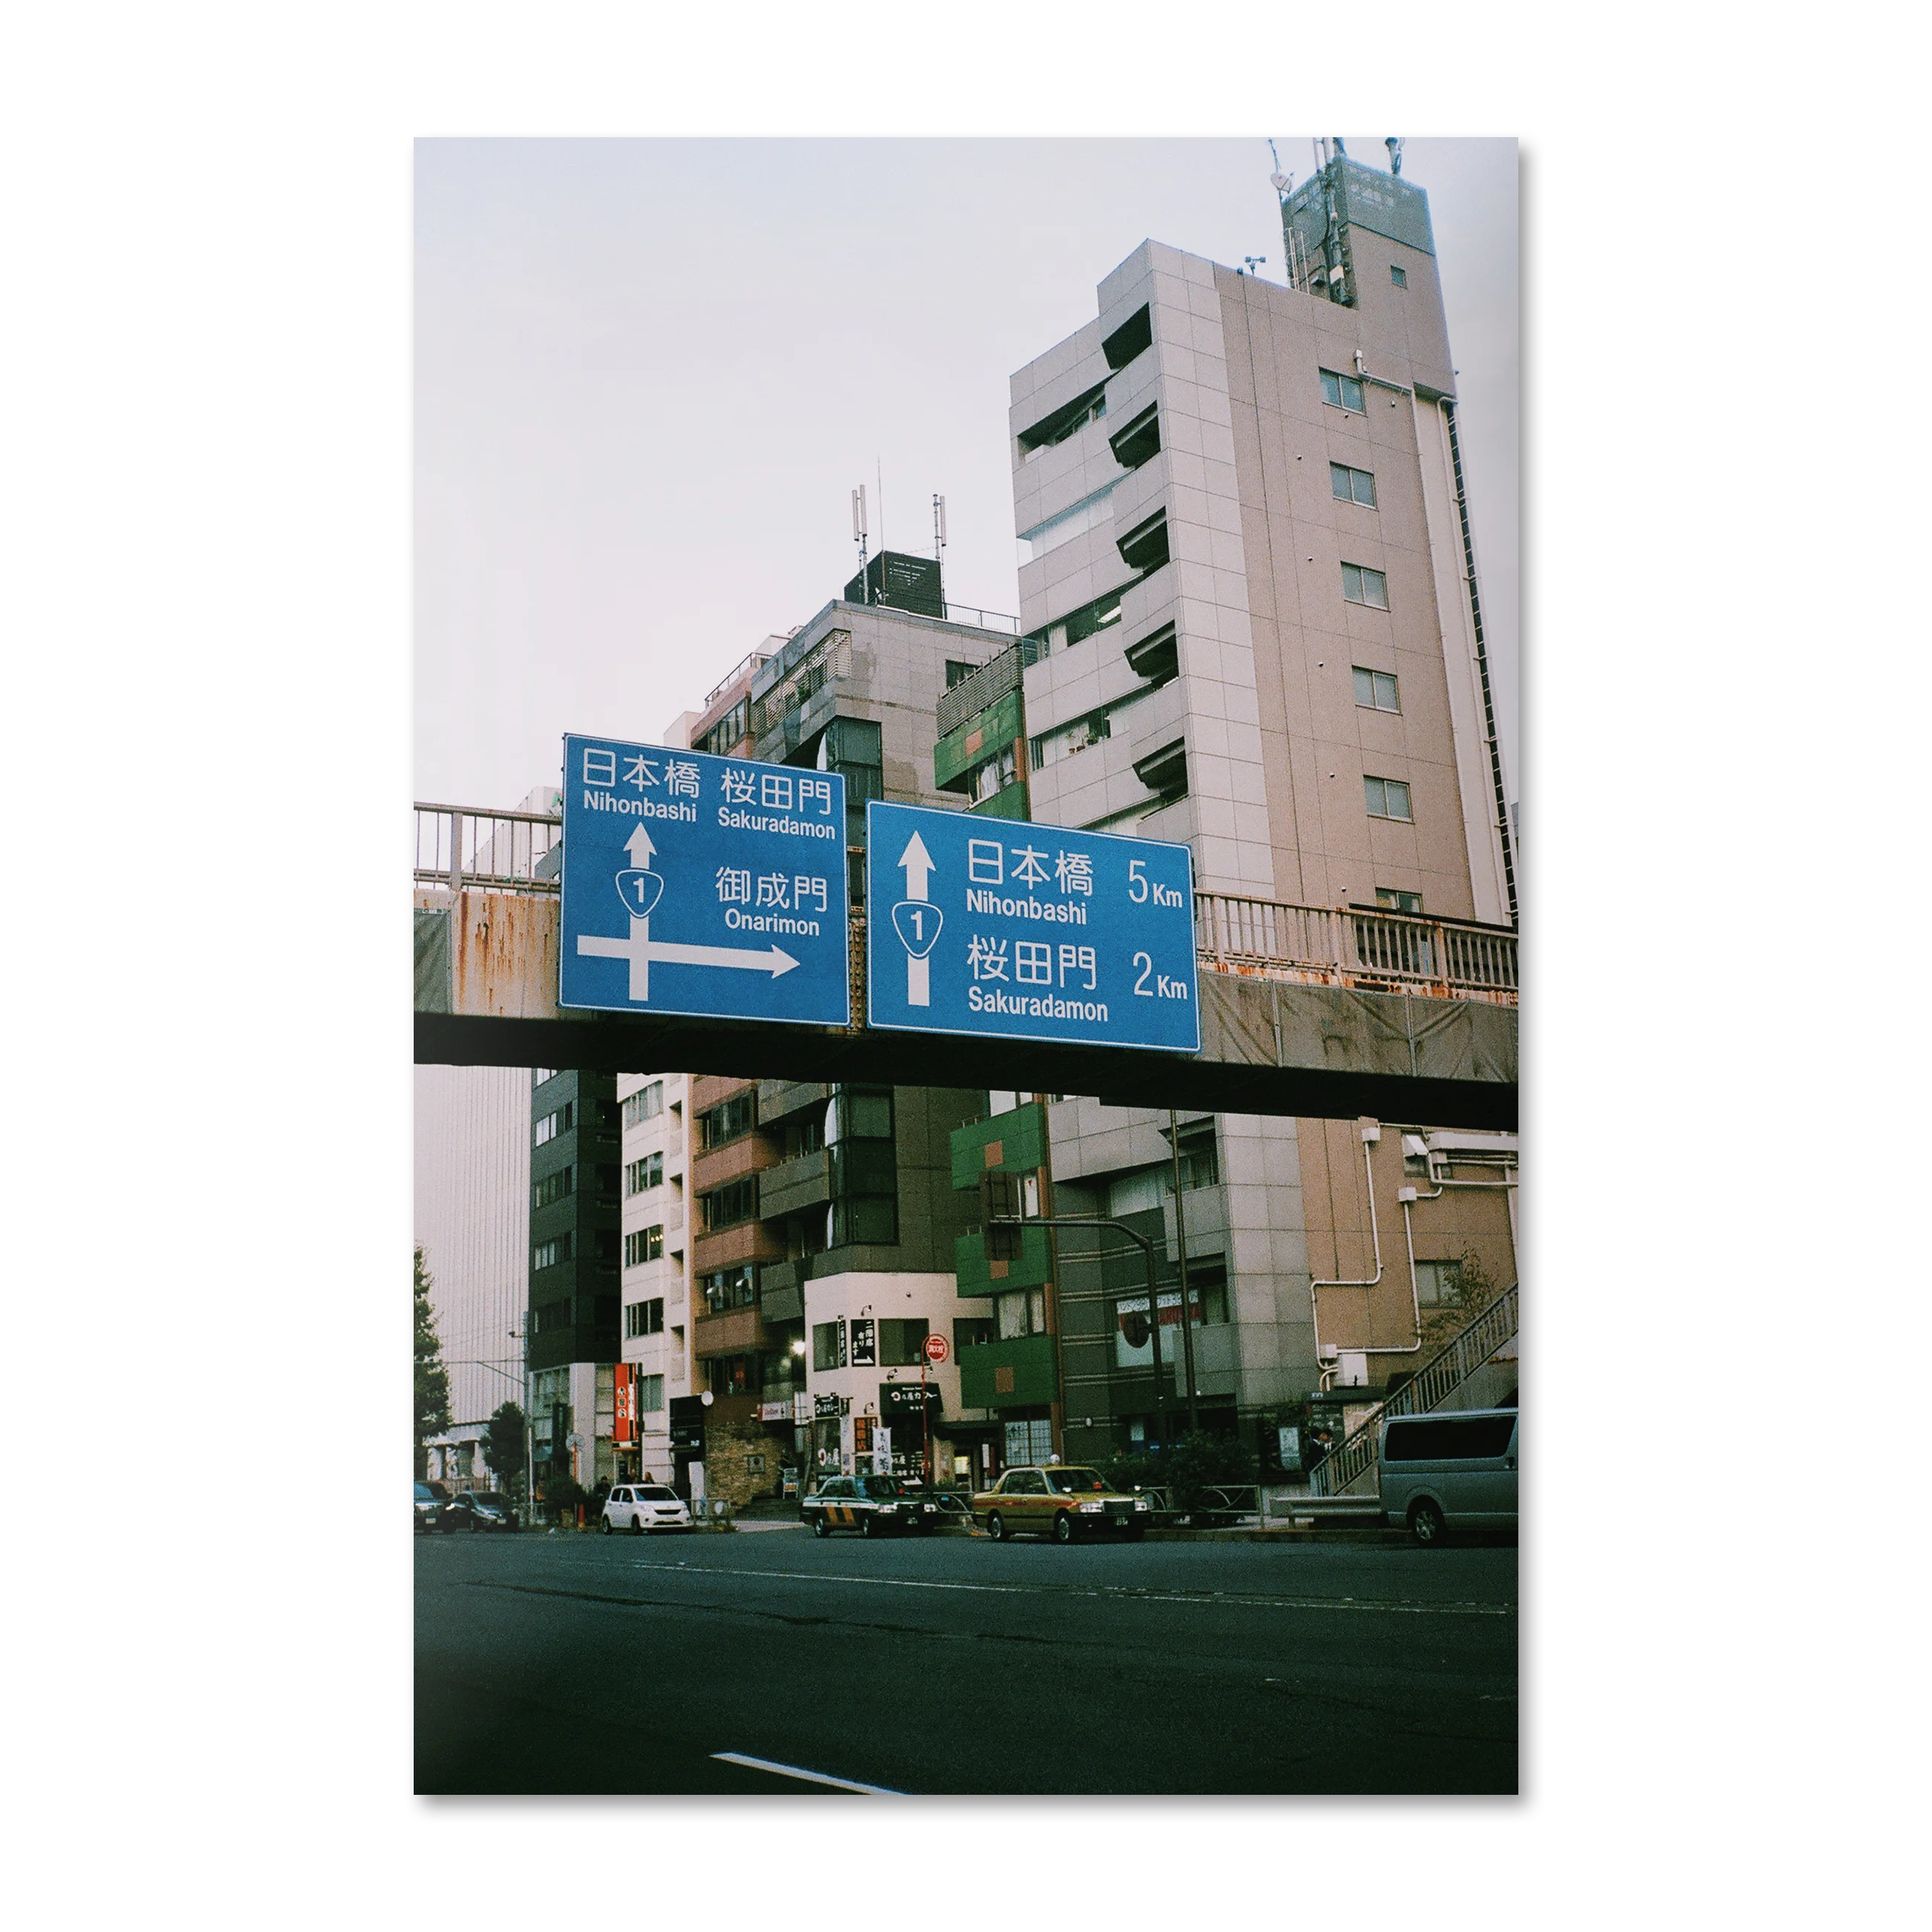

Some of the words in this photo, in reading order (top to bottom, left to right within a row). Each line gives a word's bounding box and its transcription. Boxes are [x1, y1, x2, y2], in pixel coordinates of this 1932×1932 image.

[583, 747, 701, 798] 日本橋
[720, 767, 831, 816] 桜田門
[583, 790, 697, 822] Nihonbashi
[718, 806, 836, 840] Sakuradamon
[968, 838, 1094, 896] 日本橋
[633, 877, 645, 903] 1
[715, 867, 827, 913] 御成門
[966, 888, 1087, 925] Nihonbashi
[724, 907, 820, 936] Onarimon
[910, 910, 922, 941] 1
[967, 934, 1096, 990] 桜田門
[968, 985, 1108, 1022] Sakuradamon
